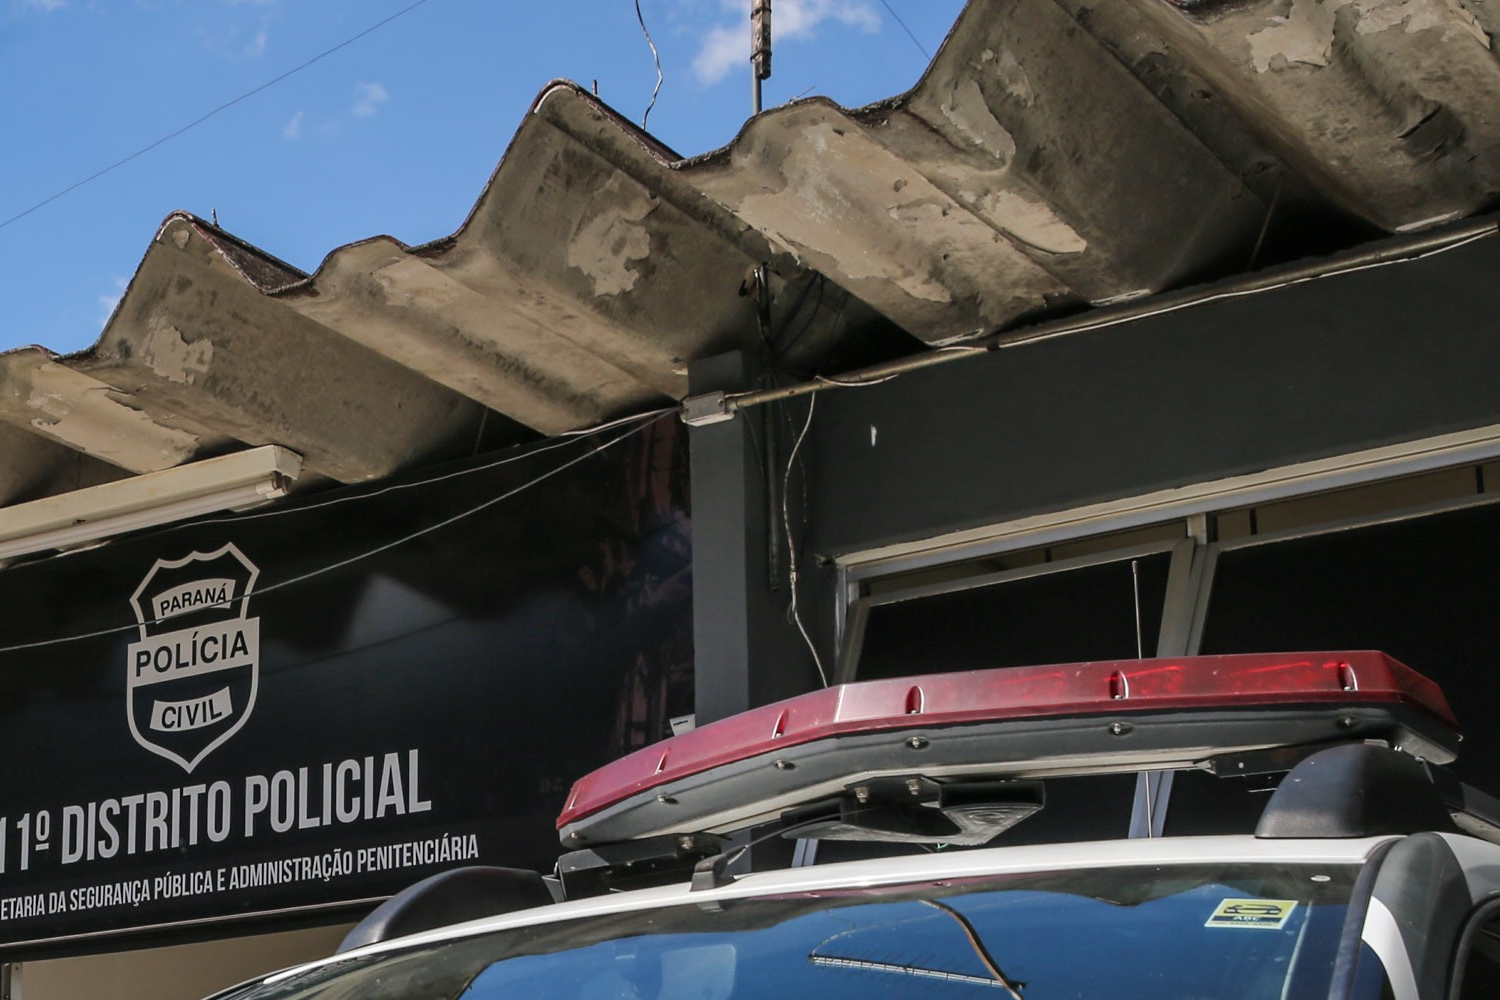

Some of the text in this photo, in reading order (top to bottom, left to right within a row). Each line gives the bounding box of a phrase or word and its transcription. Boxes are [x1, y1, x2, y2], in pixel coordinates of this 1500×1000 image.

[160, 582, 227, 616] PARANÁ
[135, 630, 249, 678] POLÍCIA
[161, 698, 223, 729] CIVIL
[60, 779, 232, 865] DISTRITO
[243, 748, 432, 838] POLICIAL
[49, 891, 67, 915] DA
[69, 879, 150, 910] SEGURANÇA
[154, 870, 213, 899] PÚBLICA
[216, 868, 226, 892] E
[229, 848, 353, 890] ADMINISTRAÇÃO
[357, 833, 479, 873] PENITENCIÁRIA
